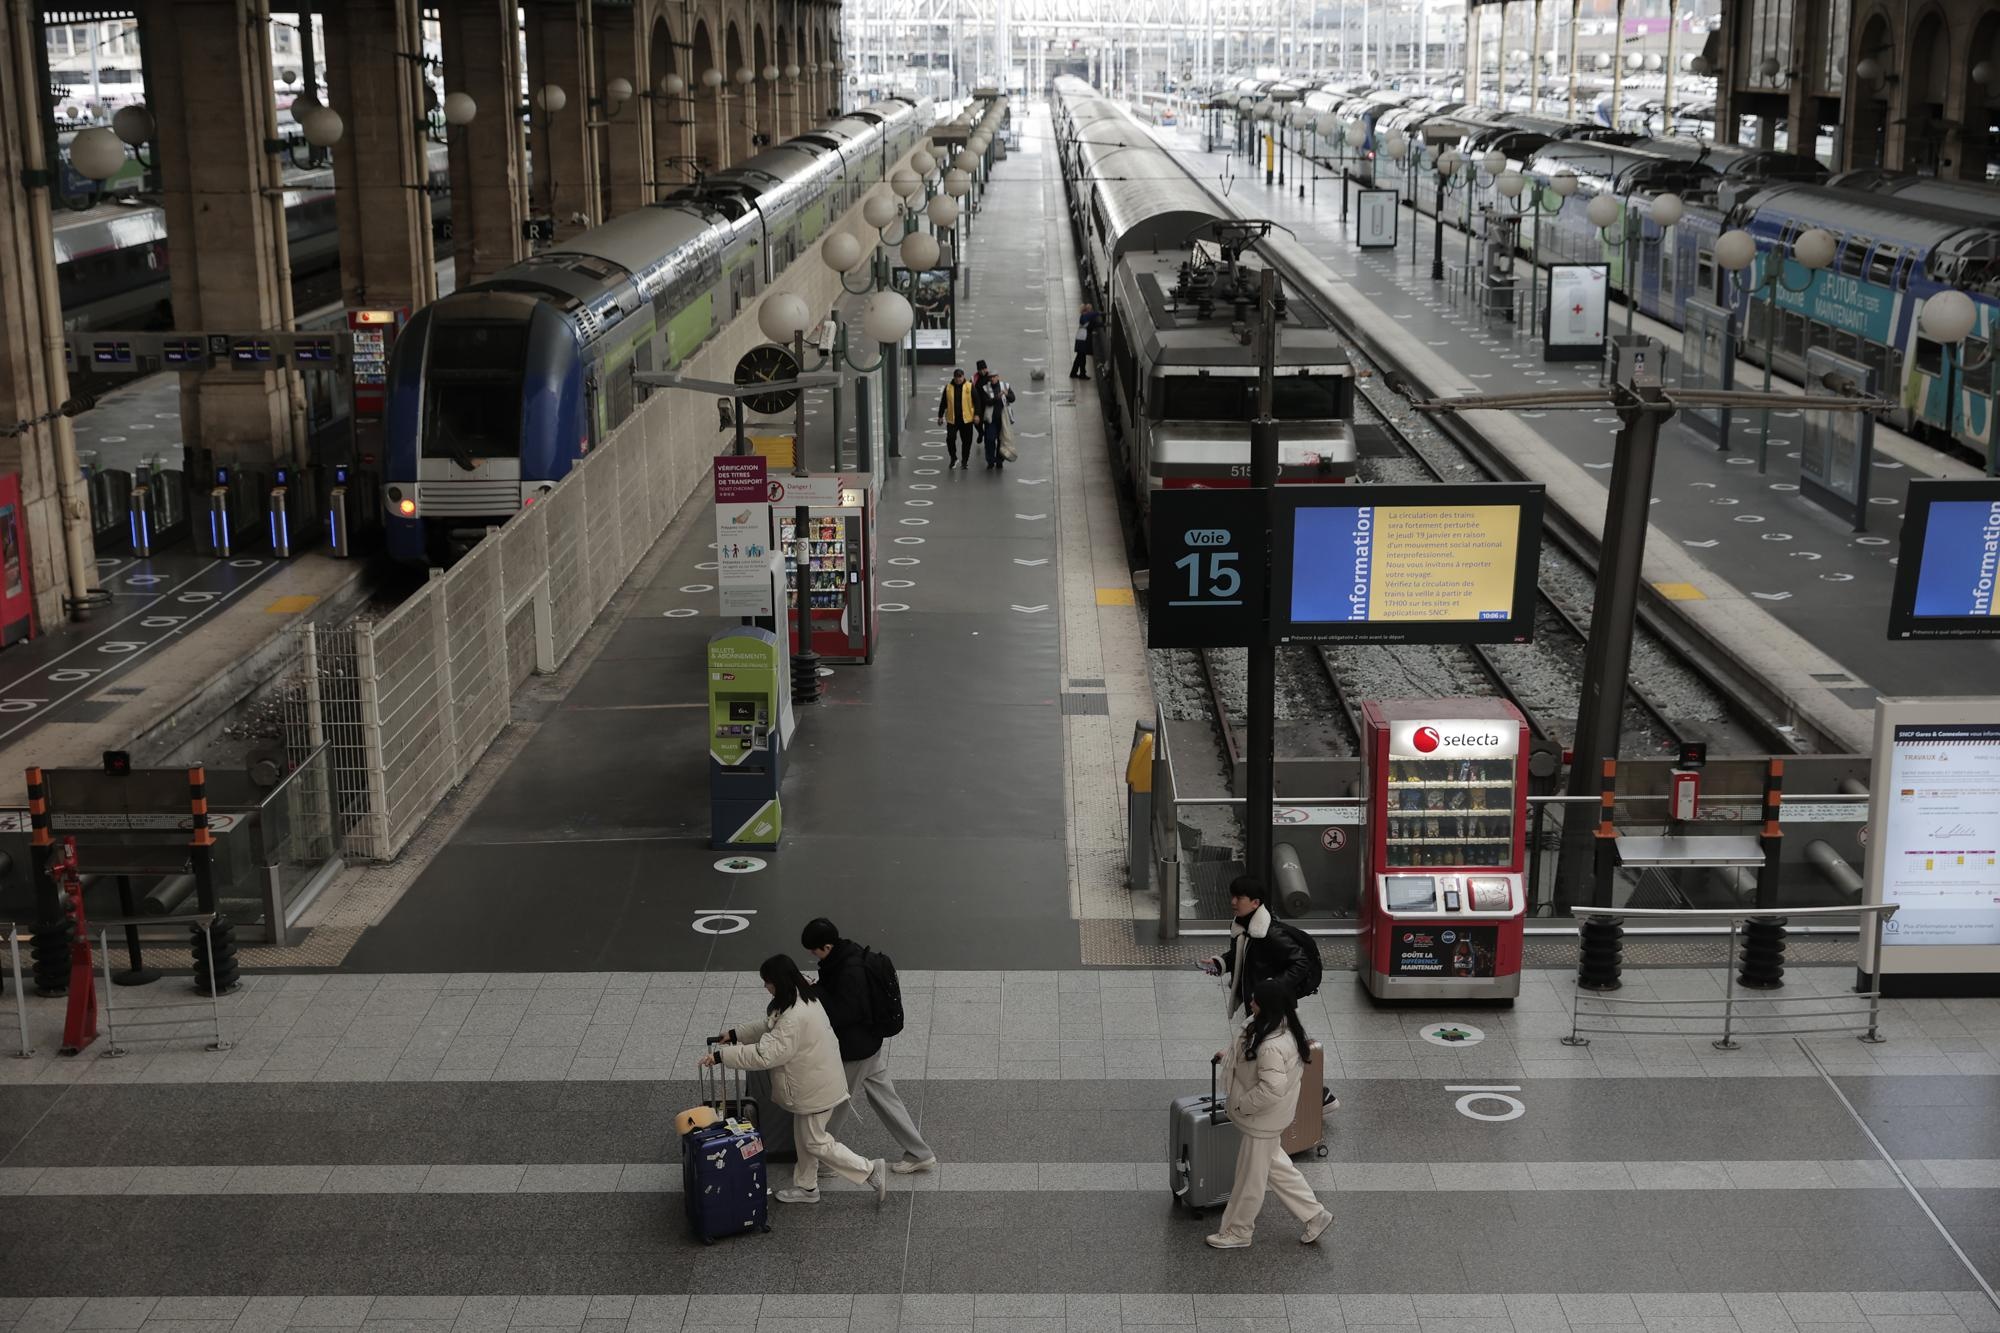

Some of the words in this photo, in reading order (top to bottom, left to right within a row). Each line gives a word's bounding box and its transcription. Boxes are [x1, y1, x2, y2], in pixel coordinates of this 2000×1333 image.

[530, 224, 540, 238] R
[1827, 273, 1858, 304] FUTUR
[1190, 532, 1224, 544] Voie
[1348, 506, 1370, 620] information
[1969, 501, 2000, 615] information
[1175, 552, 1241, 597] 15
[1444, 728, 1498, 746] selecta
